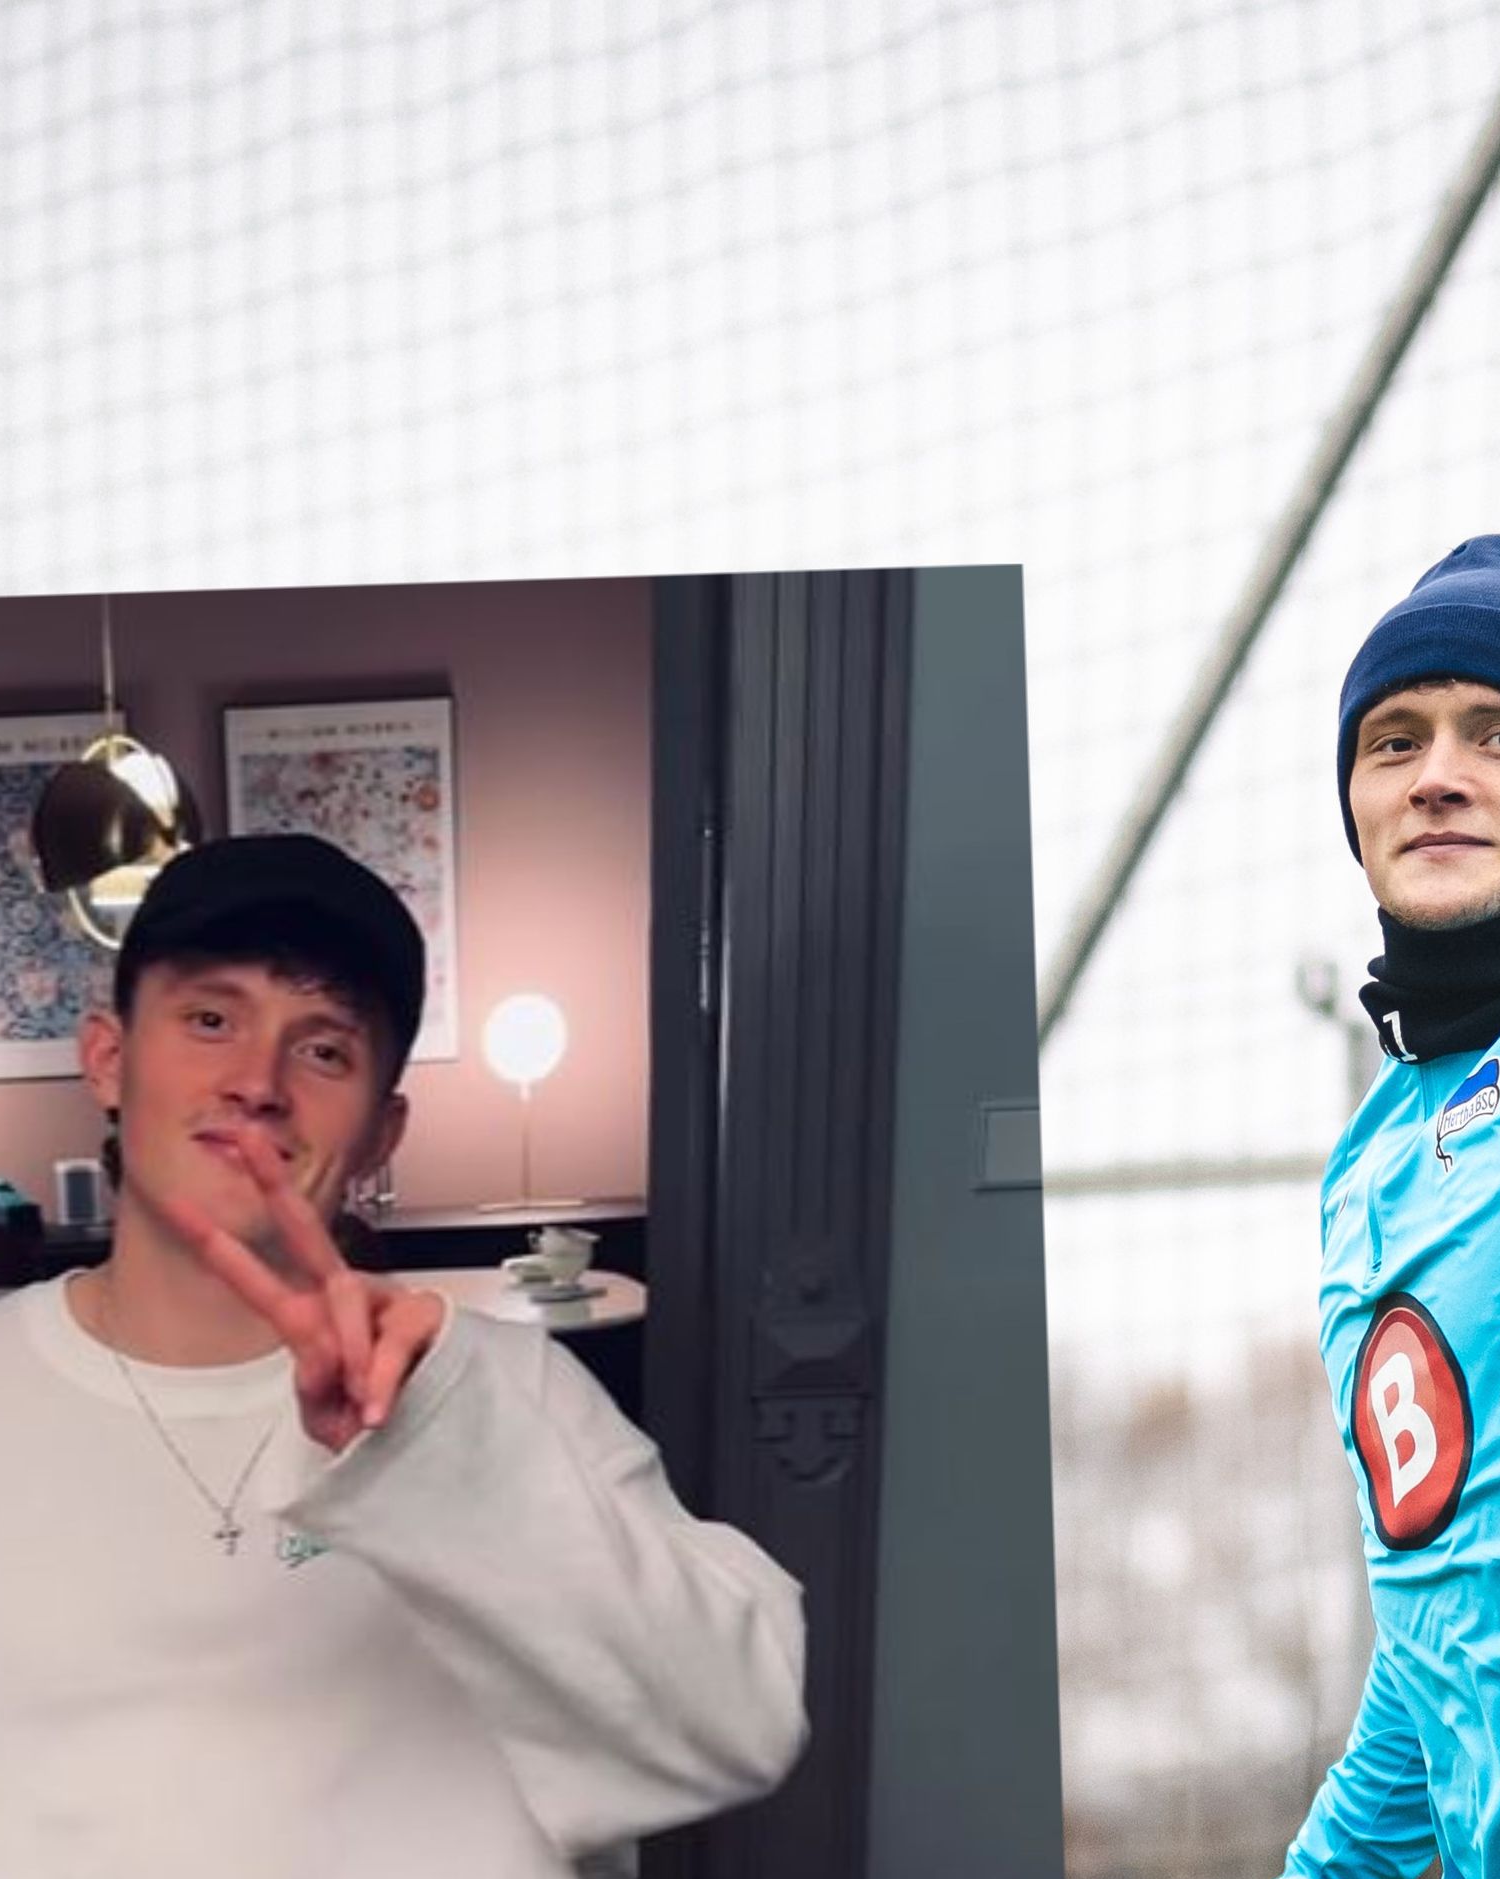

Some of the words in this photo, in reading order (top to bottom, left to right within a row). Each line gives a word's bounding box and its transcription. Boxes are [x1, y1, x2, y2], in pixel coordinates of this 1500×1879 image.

[1442, 1104, 1475, 1132] Hertha
[1474, 1089, 1496, 1114] BSC
[1369, 1352, 1438, 1508] B
